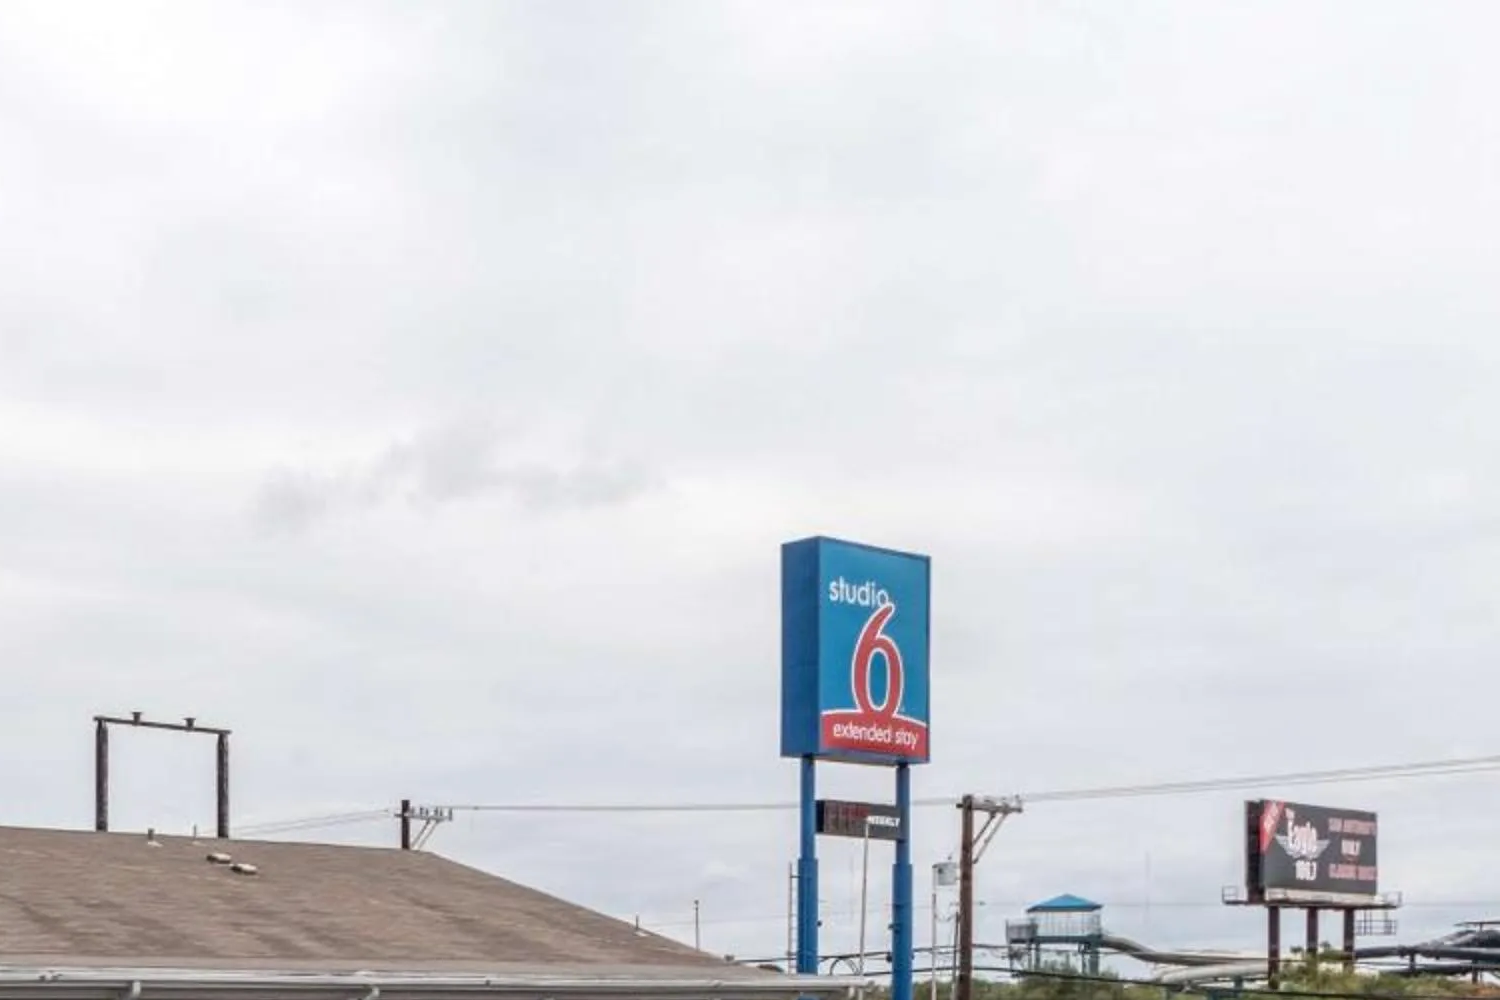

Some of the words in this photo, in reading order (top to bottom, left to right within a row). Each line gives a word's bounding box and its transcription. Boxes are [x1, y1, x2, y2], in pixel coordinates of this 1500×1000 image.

[829, 575, 890, 608] studio
[851, 602, 905, 716] 6
[833, 721, 892, 745] extended
[895, 726, 919, 750] stay
